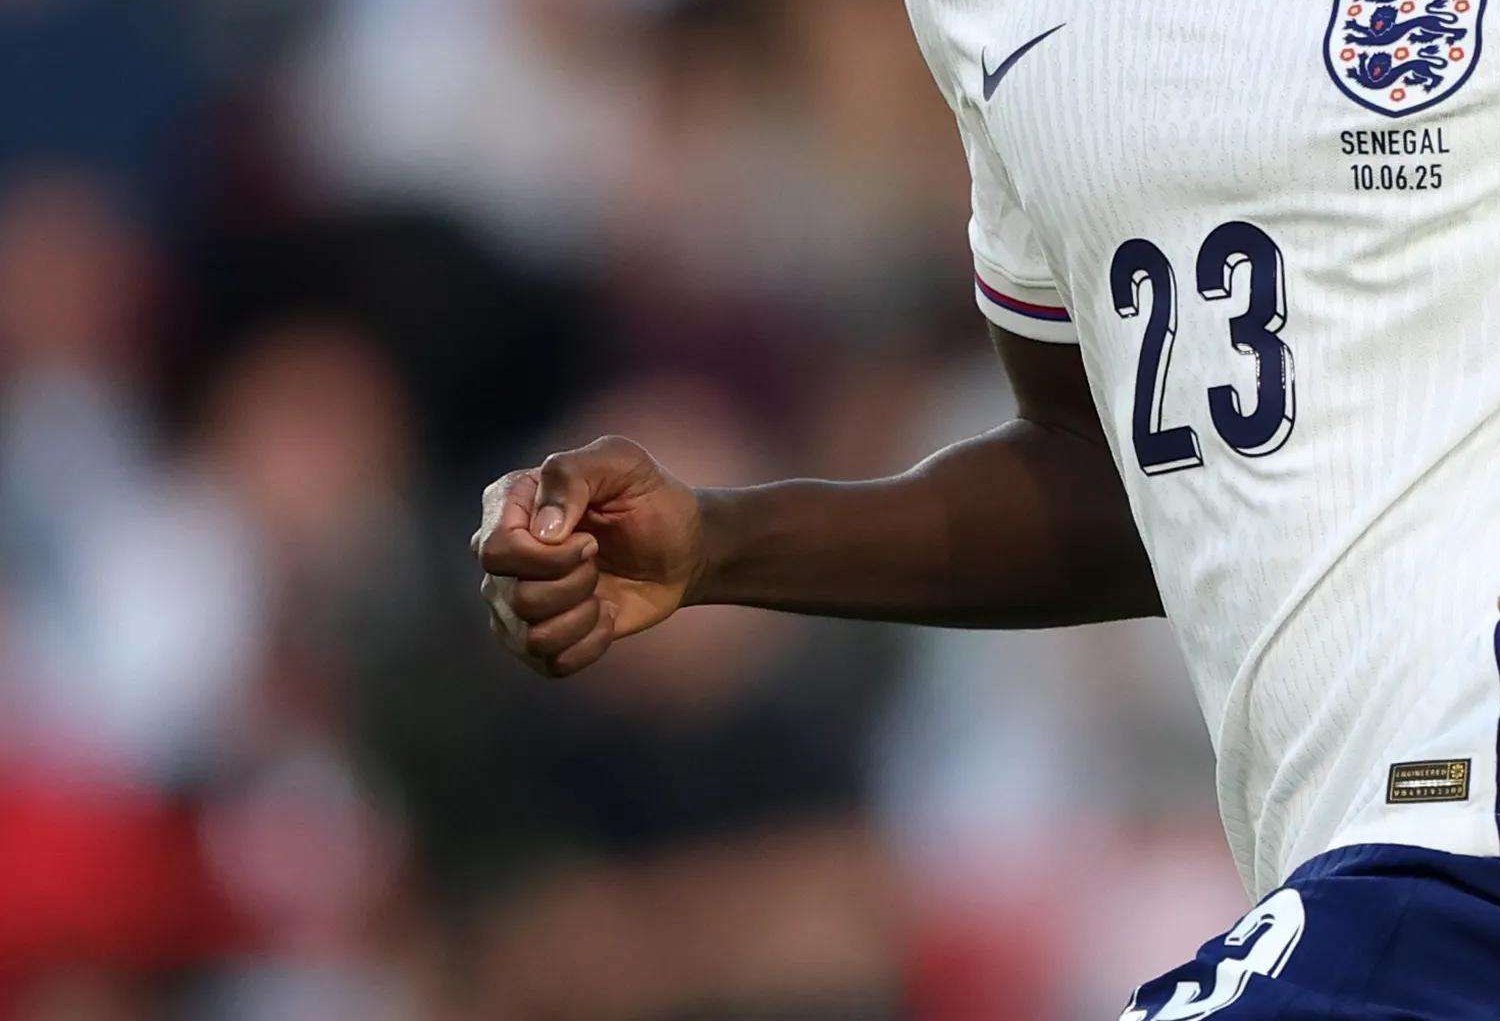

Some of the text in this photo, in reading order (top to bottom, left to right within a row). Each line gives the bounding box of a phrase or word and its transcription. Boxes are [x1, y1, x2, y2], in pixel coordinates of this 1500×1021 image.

[1340, 128, 1450, 155] SENEGAL
[1351, 164, 1442, 190] 10.06.25
[1109, 220, 1296, 477] 23
[1118, 887, 1305, 1021] 3
